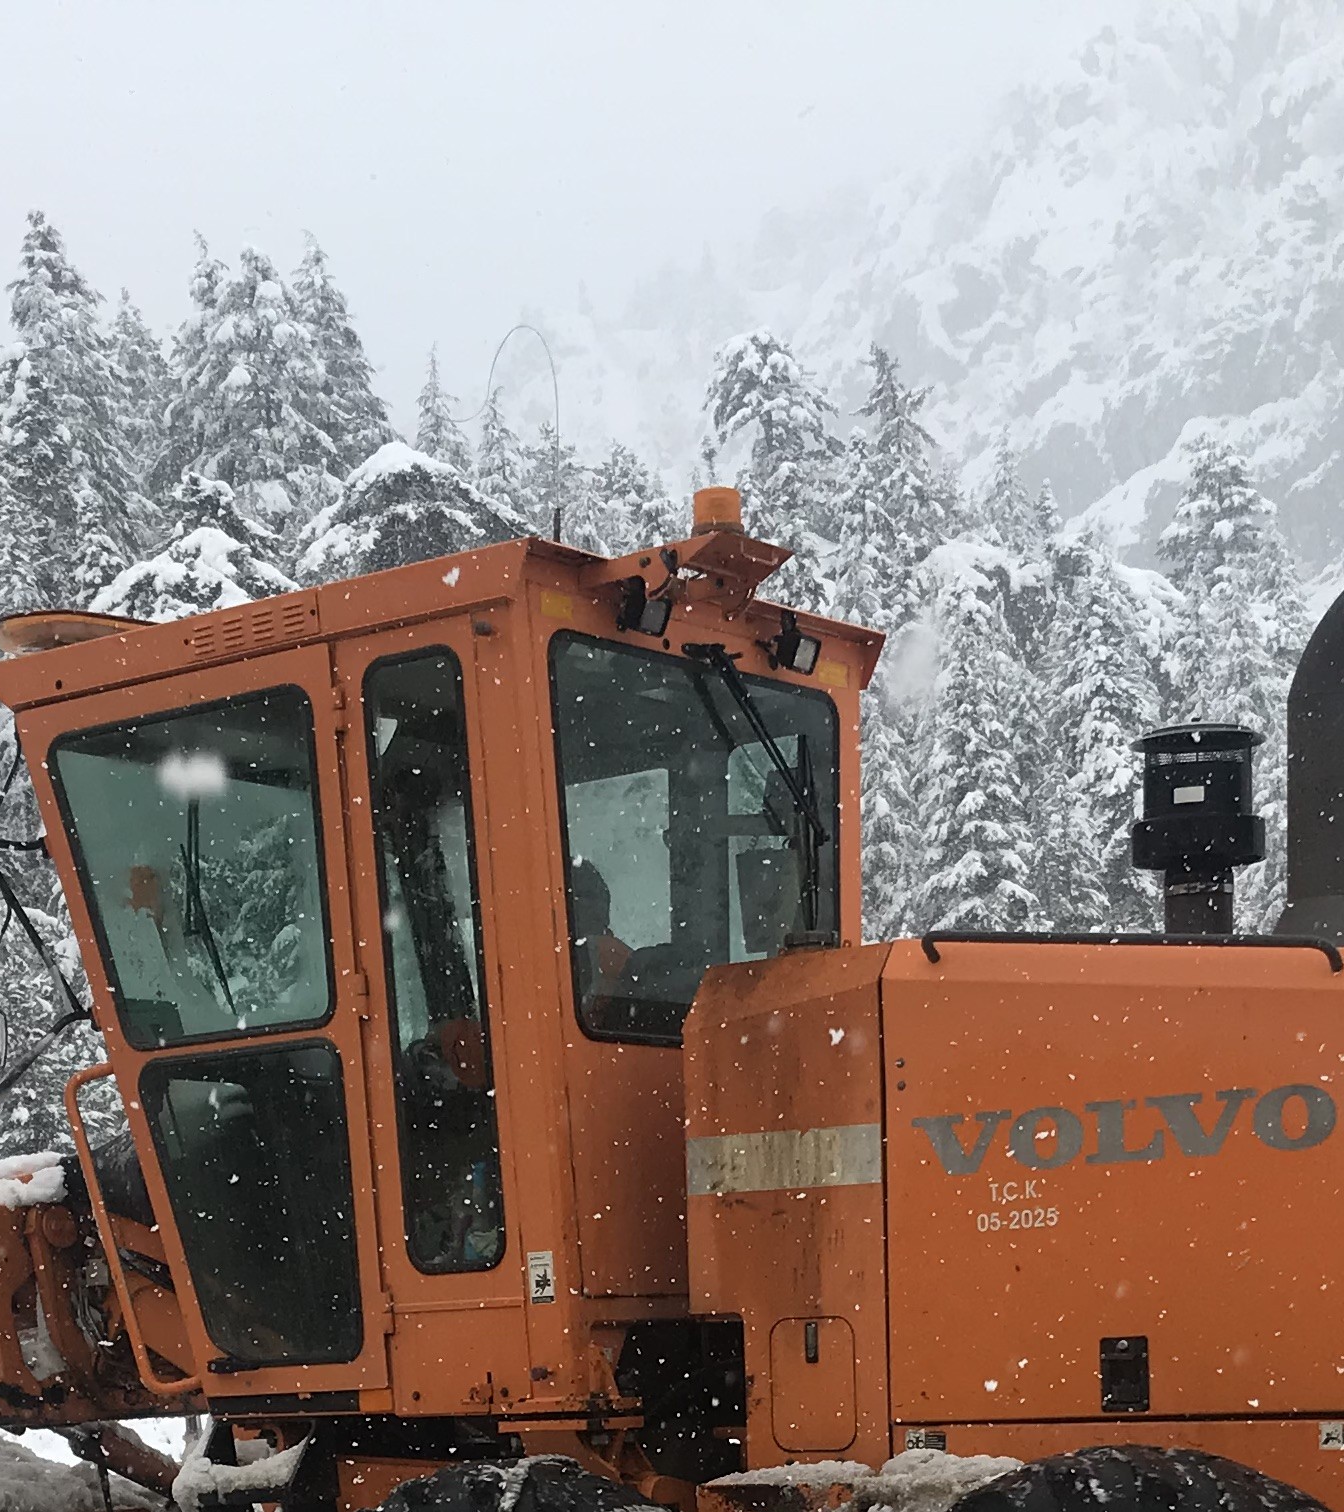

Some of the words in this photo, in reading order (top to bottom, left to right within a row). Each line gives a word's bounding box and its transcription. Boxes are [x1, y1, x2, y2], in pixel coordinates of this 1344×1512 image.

[911, 1082, 1337, 1177] VOLVO
[989, 1180, 1042, 1202] T.C.K.
[976, 1207, 1058, 1232] 05-2025
